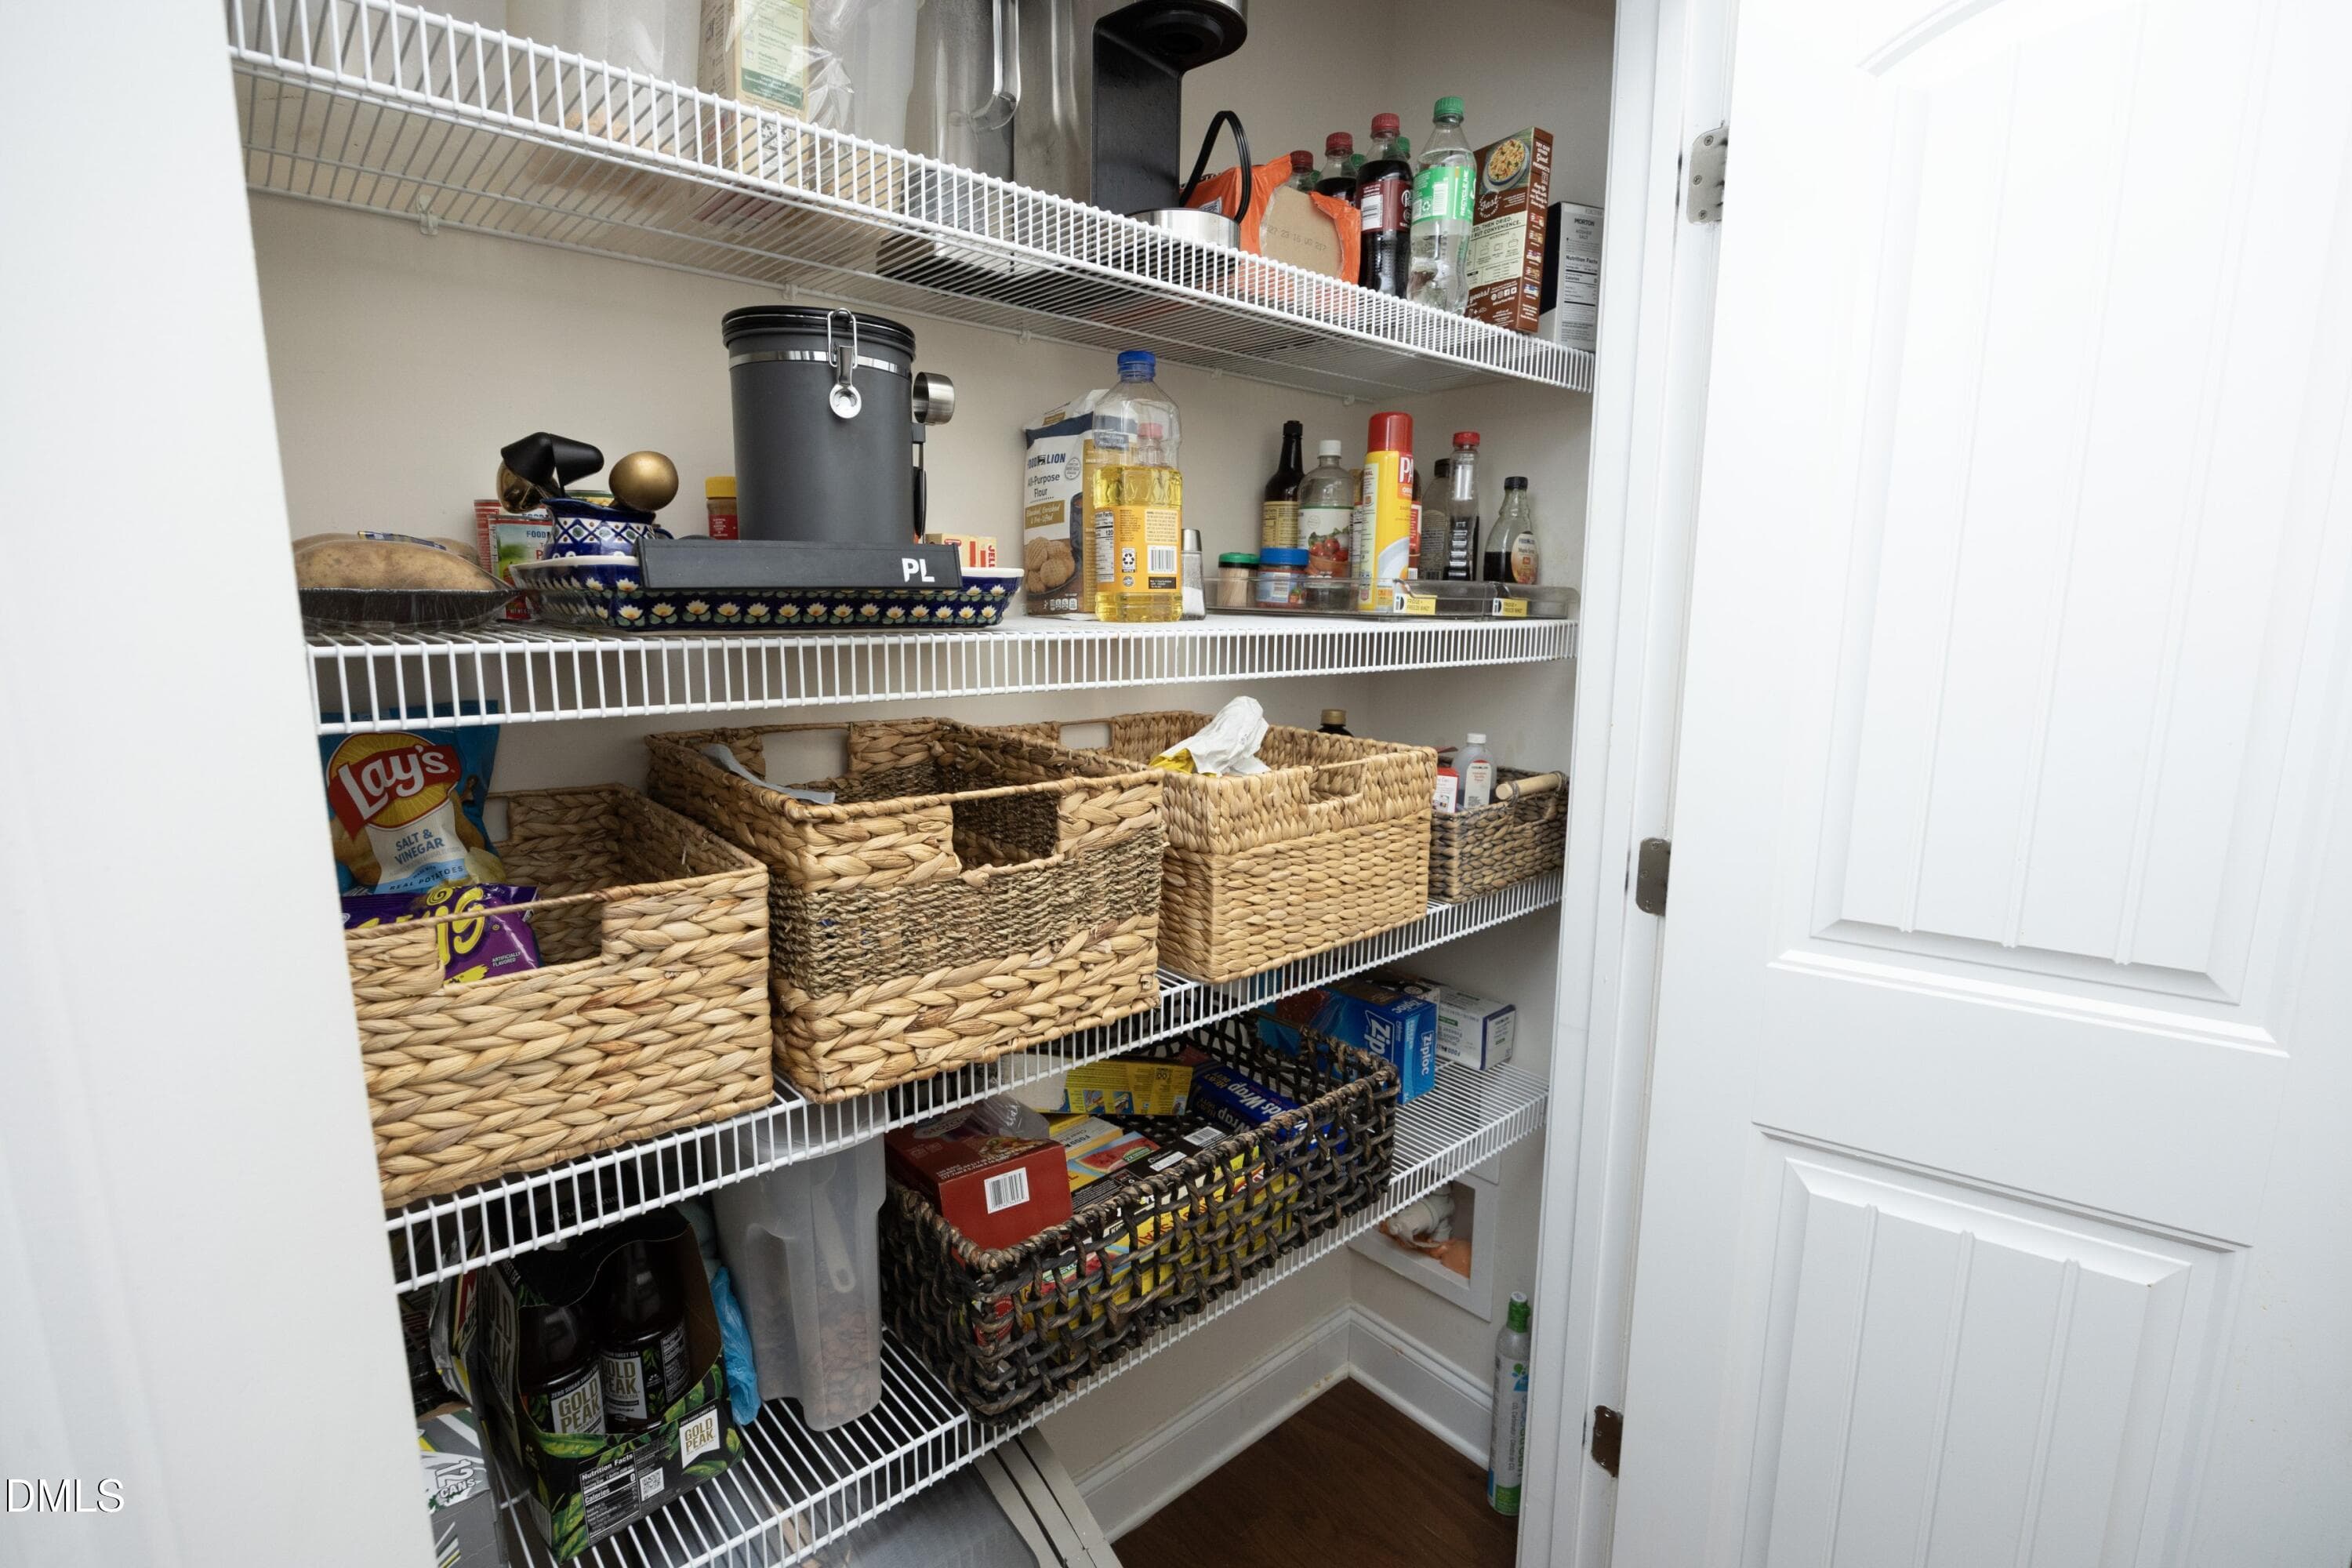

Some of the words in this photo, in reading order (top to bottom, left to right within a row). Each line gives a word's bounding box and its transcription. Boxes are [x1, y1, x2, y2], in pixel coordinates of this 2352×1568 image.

[1574, 218, 1595, 227] MORTON
[1047, 452, 1066, 463] LION
[1028, 473, 1061, 488] All-Purpose
[1034, 487, 1048, 498] Flour
[902, 557, 935, 583] PL
[338, 745, 450, 820] Lay's
[394, 837, 445, 865] VINEGAR
[396, 832, 420, 851] SALT
[423, 829, 434, 840] &
[389, 881, 415, 891] REAL
[419, 865, 464, 885] POTATOES
[492, 951, 521, 964] ARTIFICIALLY
[492, 958, 517, 967] FLAVORED
[1363, 1019, 1392, 1056] Zip
[1420, 1033, 1432, 1075] Ziploc
[1228, 1082, 1265, 1110] Wrap
[551, 1389, 564, 1399] ZERO
[564, 1381, 581, 1393] SUGAR
[558, 1377, 598, 1417] GOLD
[561, 1397, 601, 1433] PEAK
[688, 1414, 699, 1423] SUGAR
[699, 1409, 709, 1417] SWEET
[684, 1417, 713, 1442] GOLD
[685, 1432, 714, 1453] PEAK
[435, 1458, 475, 1490] 12
[582, 1464, 612, 1481] Nutrition
[614, 1454, 633, 1465] Facts
[630, 1473, 636, 1482] 0
[440, 1479, 476, 1498] CANS
[584, 1488, 611, 1504] Calories
